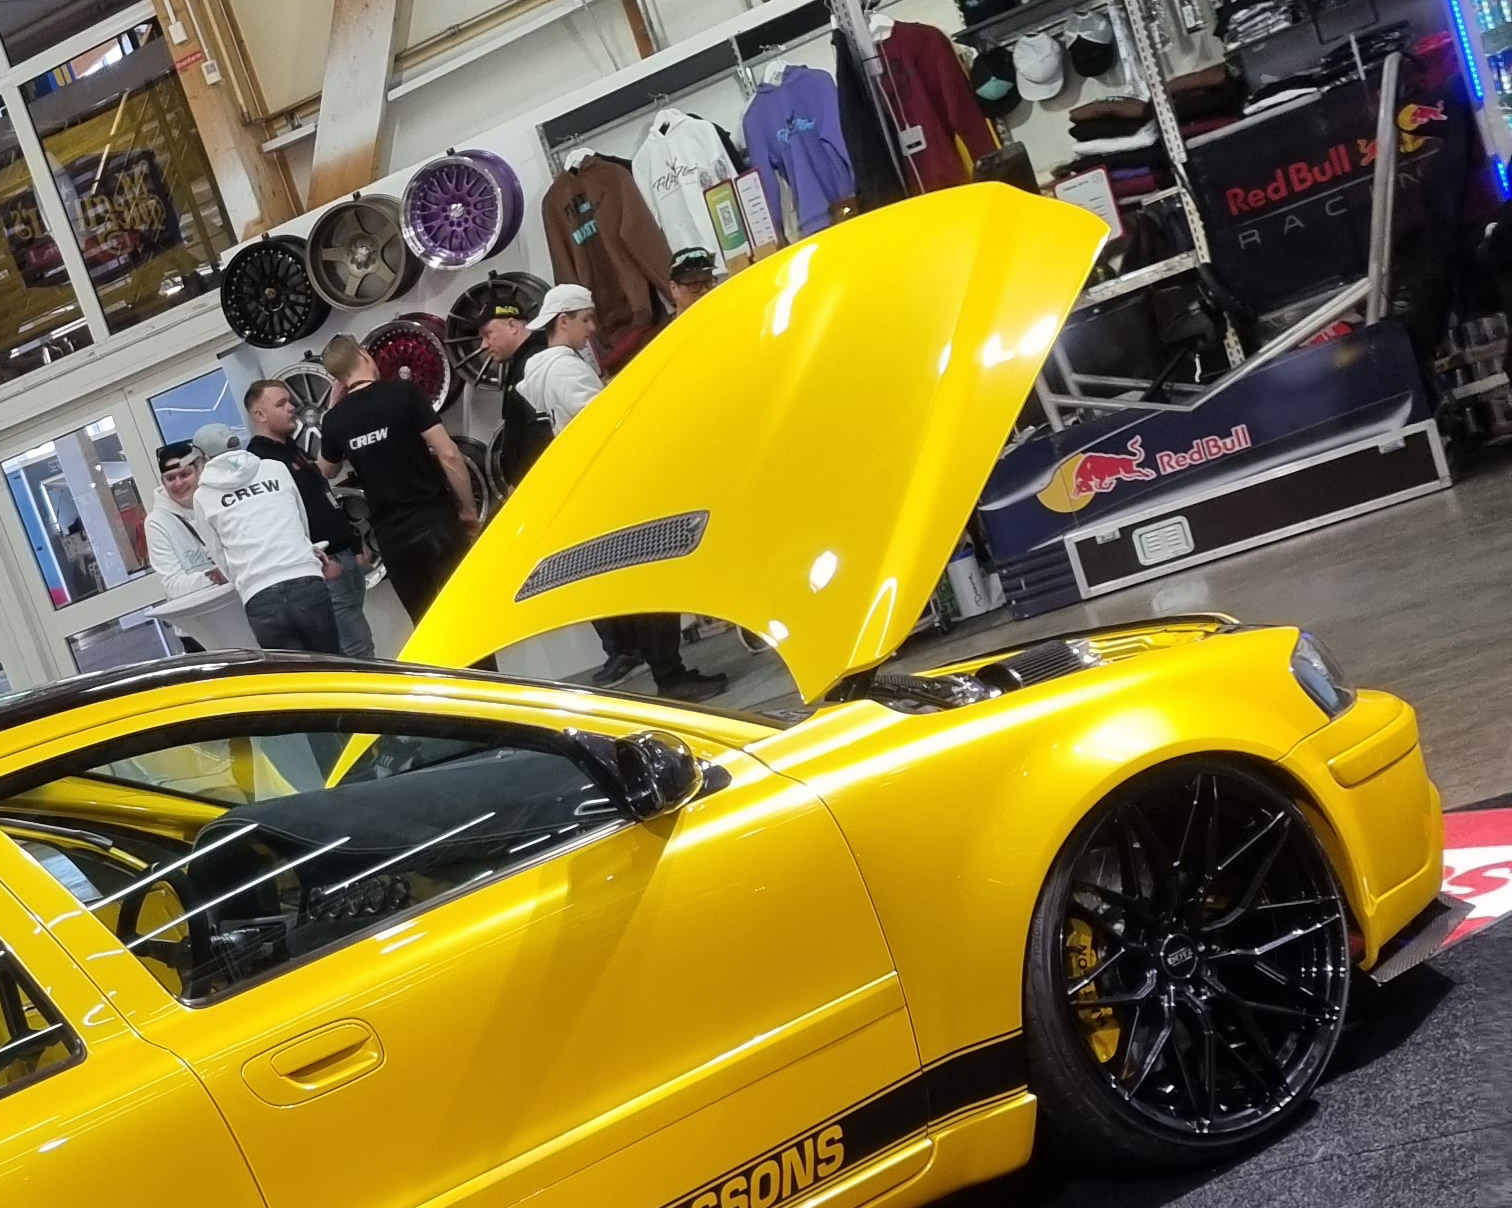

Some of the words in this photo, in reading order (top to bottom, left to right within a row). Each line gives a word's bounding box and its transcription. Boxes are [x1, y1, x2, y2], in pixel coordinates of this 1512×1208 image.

[1226, 168, 1288, 216] Red
[1288, 144, 1352, 193] Bull
[349, 427, 389, 451] CREW
[1157, 440, 1206, 476] Red
[1204, 424, 1253, 464] Bull
[220, 478, 281, 508] CREW
